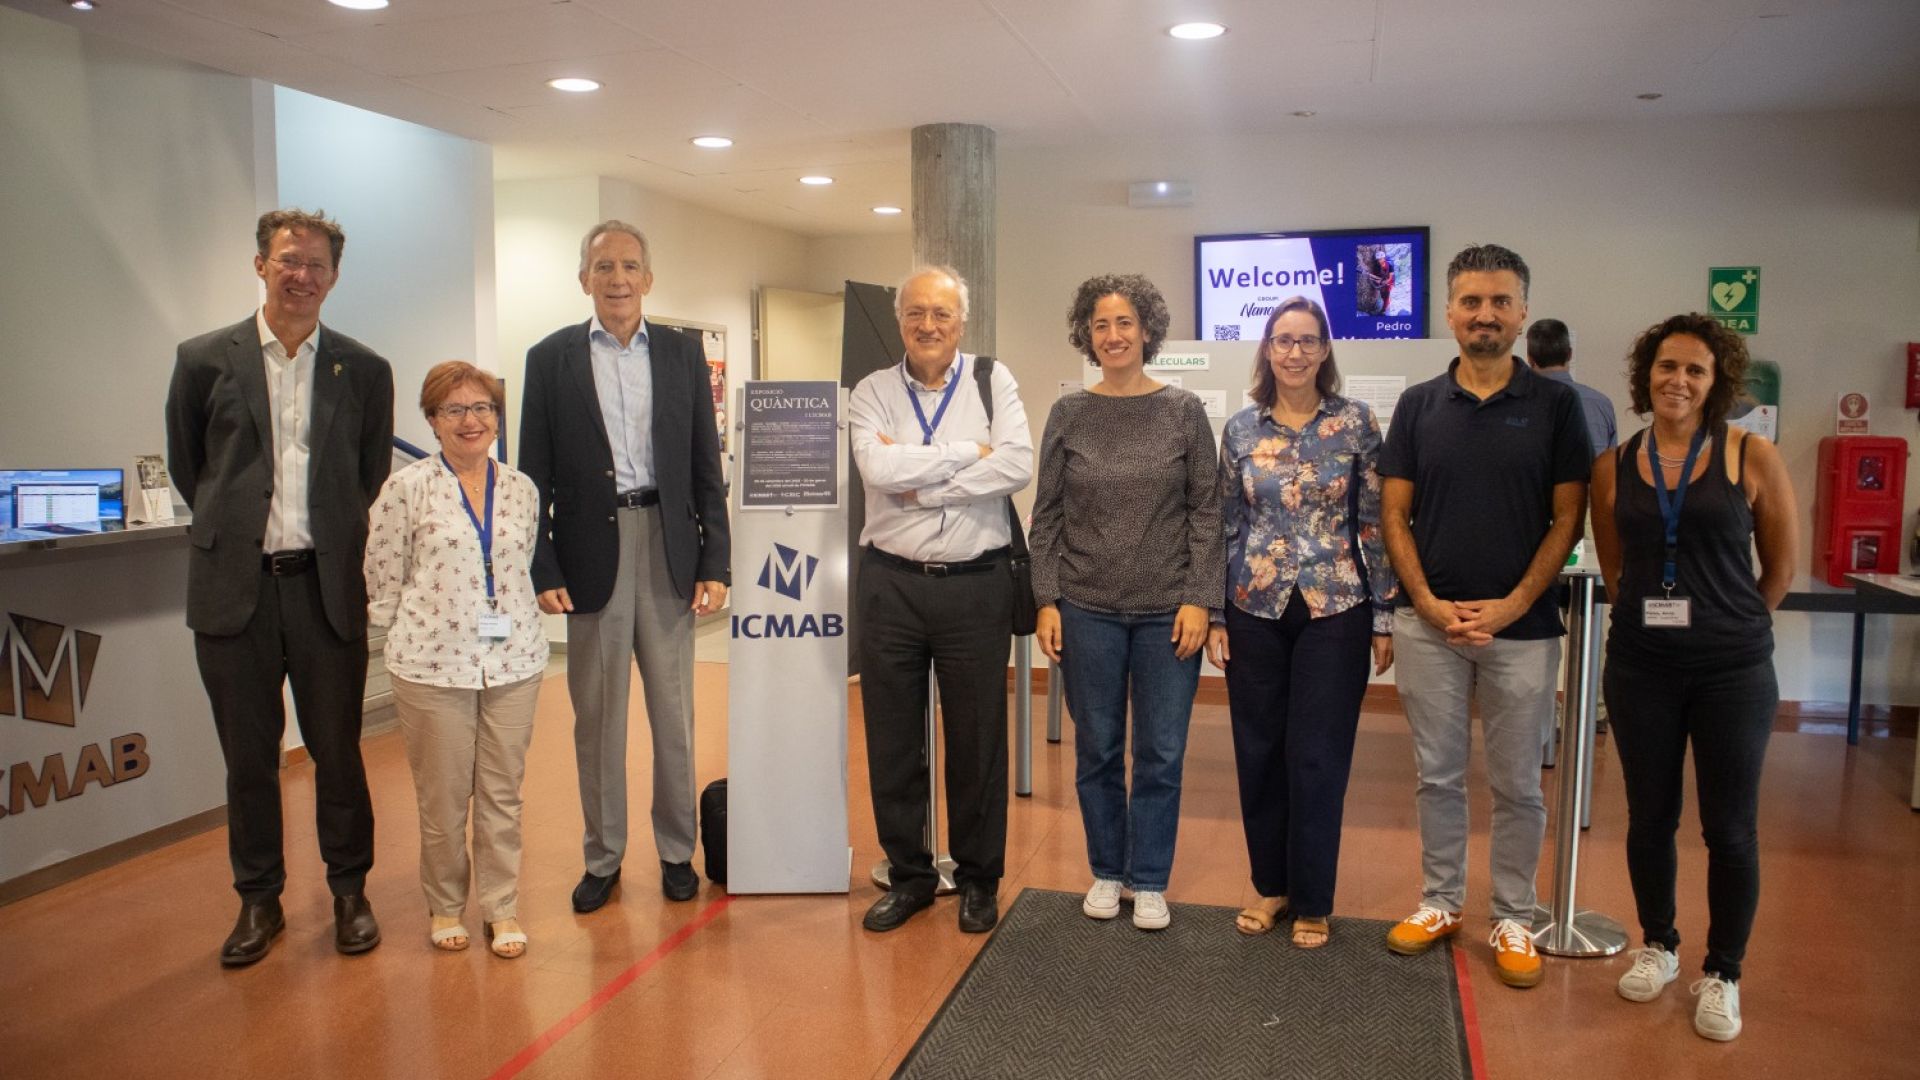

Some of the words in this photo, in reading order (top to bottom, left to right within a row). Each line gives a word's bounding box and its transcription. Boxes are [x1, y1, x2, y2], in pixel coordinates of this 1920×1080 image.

[1208, 262, 1344, 288] Welcome!
[1240, 302, 1274, 318] Nano
[1376, 321, 1412, 331] Pedro
[750, 397, 829, 412] QUÀNTICA
[731, 613, 844, 638] ICMAB
[0, 732, 151, 819] MAB
